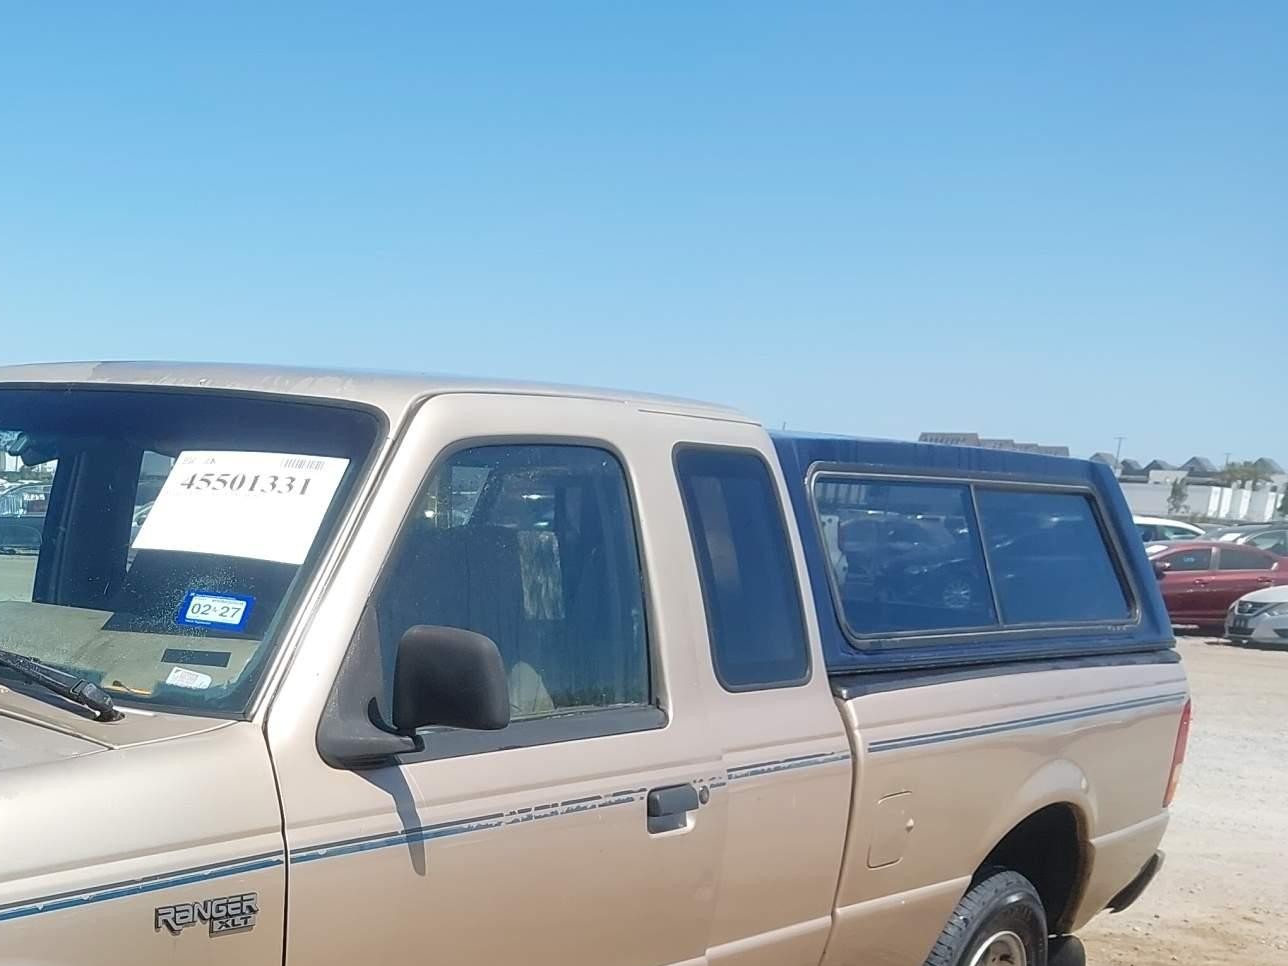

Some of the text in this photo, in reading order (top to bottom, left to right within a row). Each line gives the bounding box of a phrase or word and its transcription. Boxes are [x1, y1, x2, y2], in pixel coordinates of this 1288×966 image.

[179, 472, 312, 496] 45501331
[190, 602, 242, 619] 02 27
[154, 891, 259, 932] RANGER
[216, 915, 253, 931] XLT
